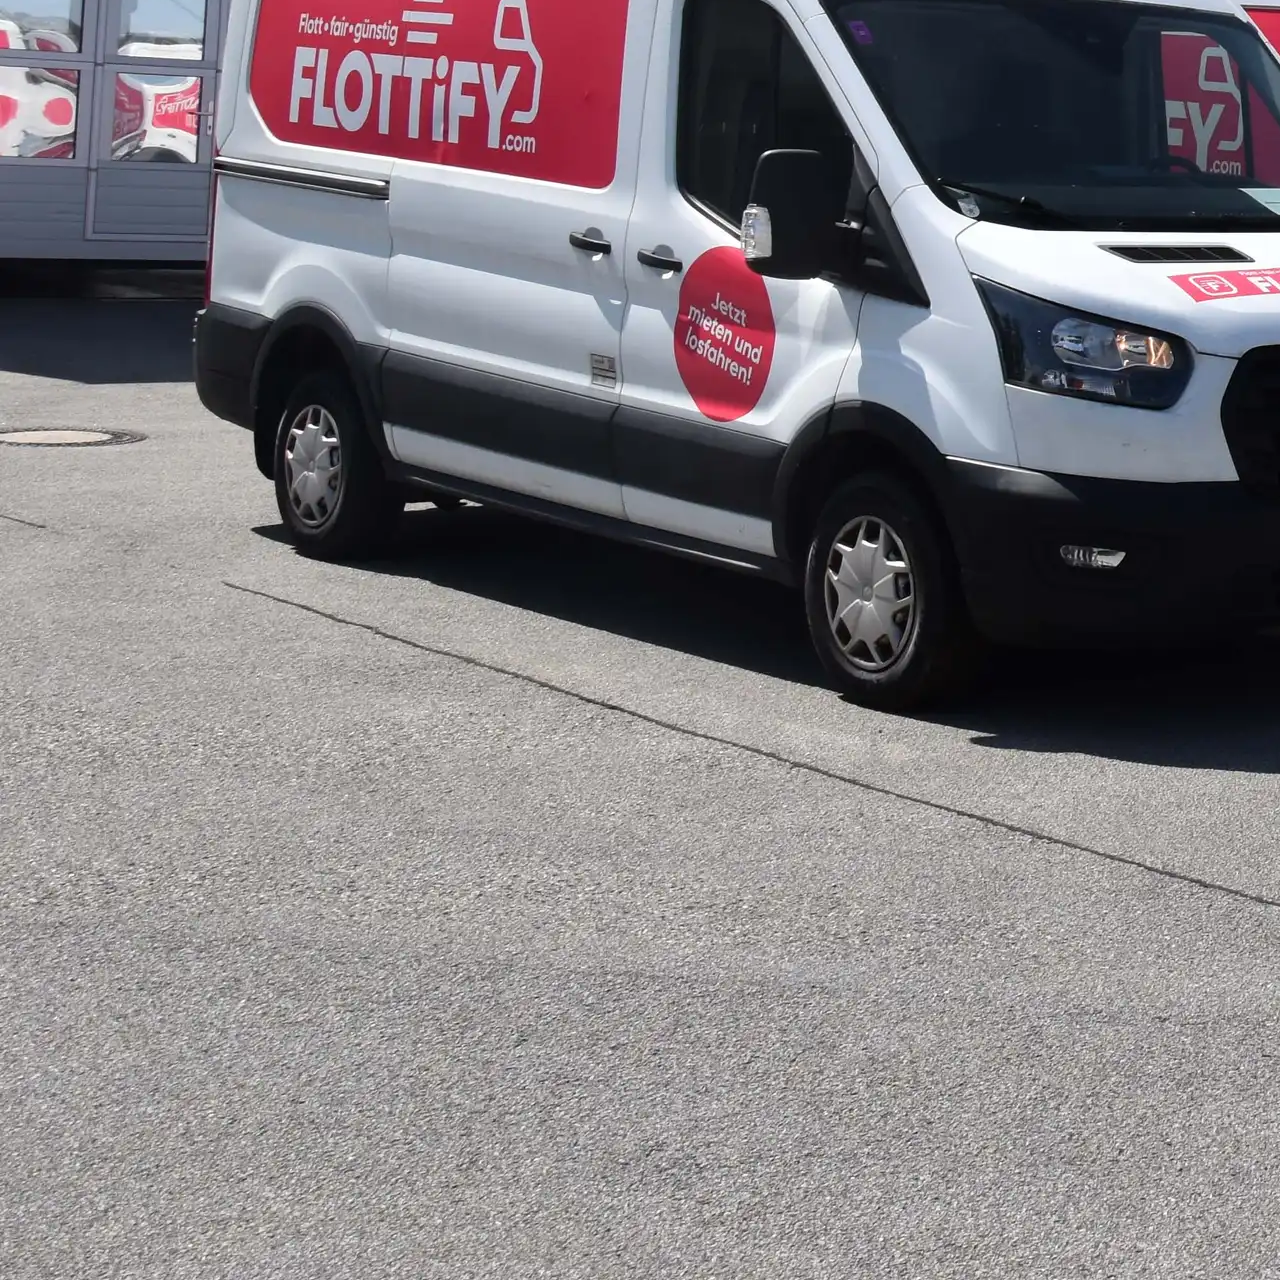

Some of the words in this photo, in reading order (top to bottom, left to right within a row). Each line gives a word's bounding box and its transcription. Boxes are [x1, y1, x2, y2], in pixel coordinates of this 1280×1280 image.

[687, 305, 733, 346] mieten
[734, 340, 763, 365] und
[711, 292, 748, 327] Jetzt
[685, 326, 753, 385] losfahren!
